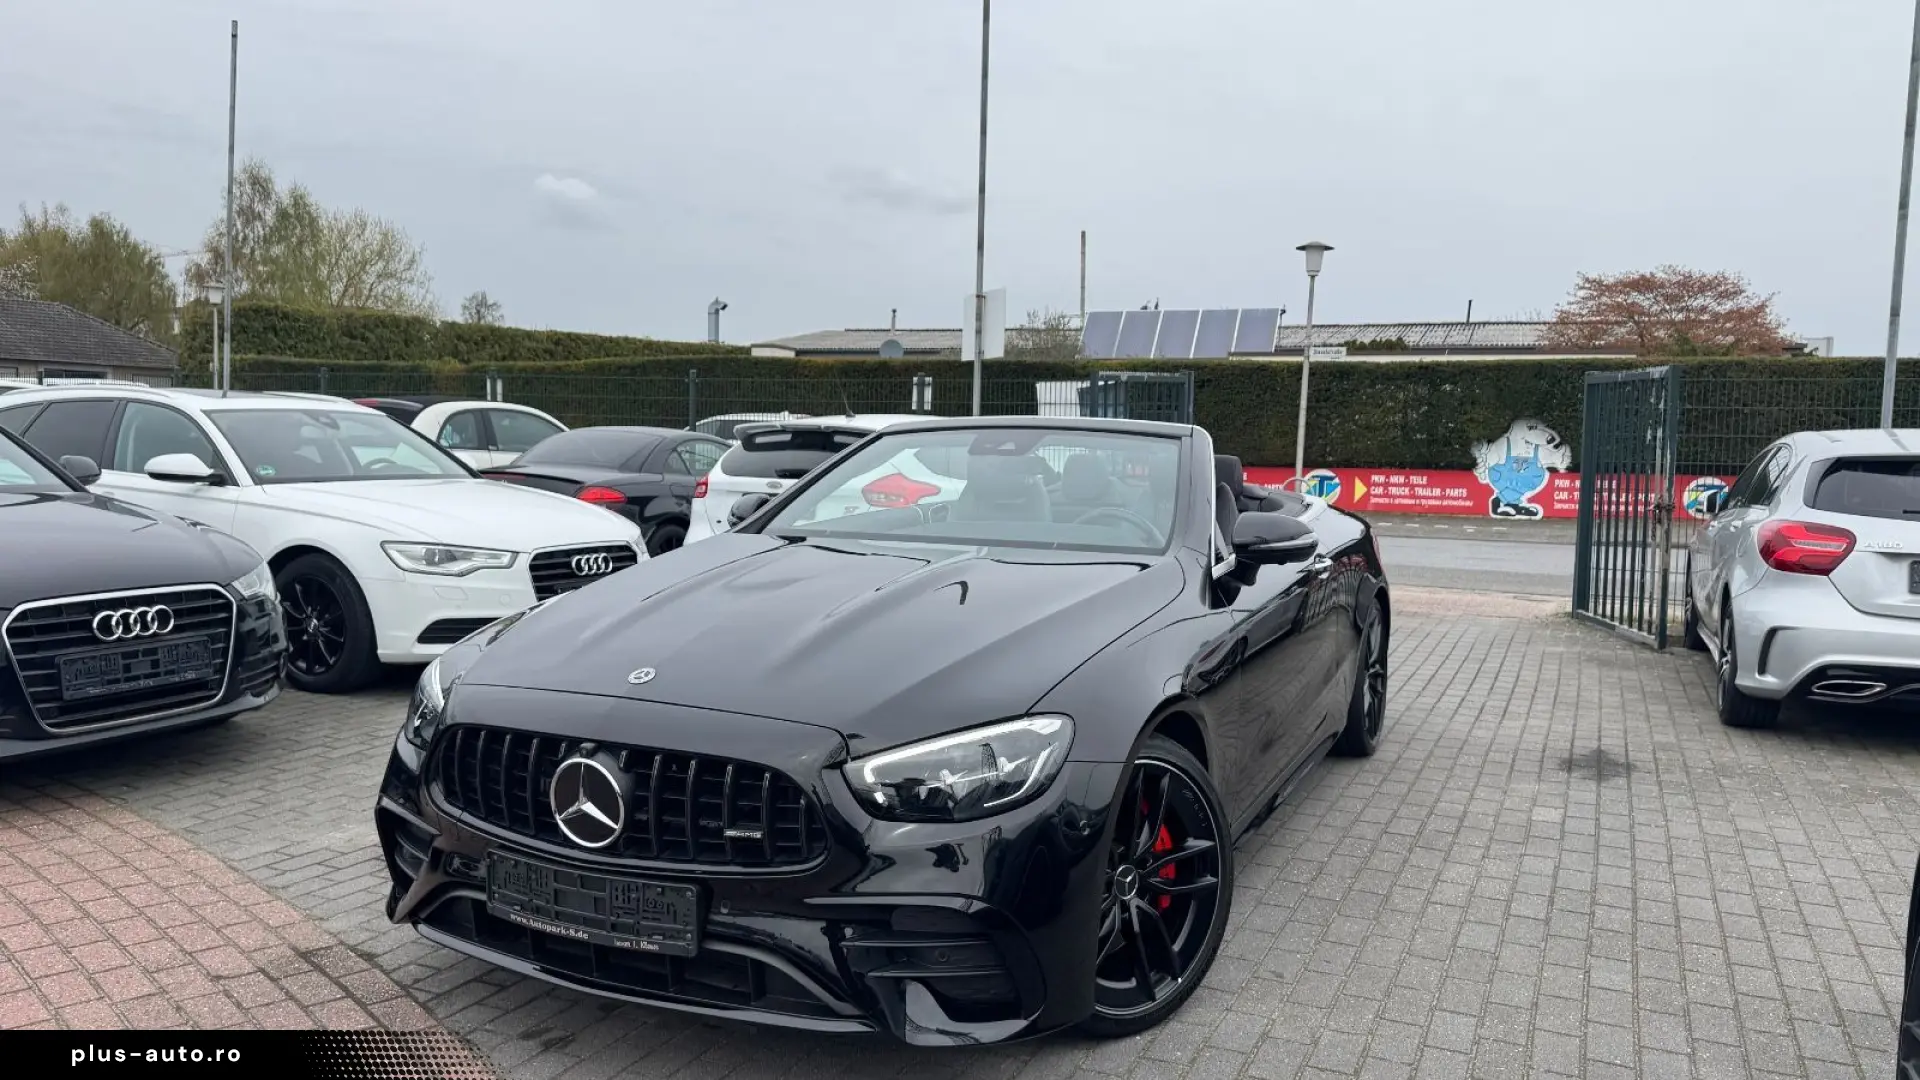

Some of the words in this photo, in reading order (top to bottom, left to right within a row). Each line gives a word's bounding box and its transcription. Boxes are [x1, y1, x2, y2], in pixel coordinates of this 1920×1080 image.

[1370, 474, 1386, 484] PKW
[1409, 475, 1428, 485] TEILE
[1370, 486, 1384, 495] CAR
[1388, 486, 1410, 496] TRUCK
[1414, 487, 1441, 497] TRAILER
[1445, 487, 1468, 498] PARTS
[1554, 491, 1568, 500] CAR
[510, 913, 589, 940] www.Autopark-S.de
